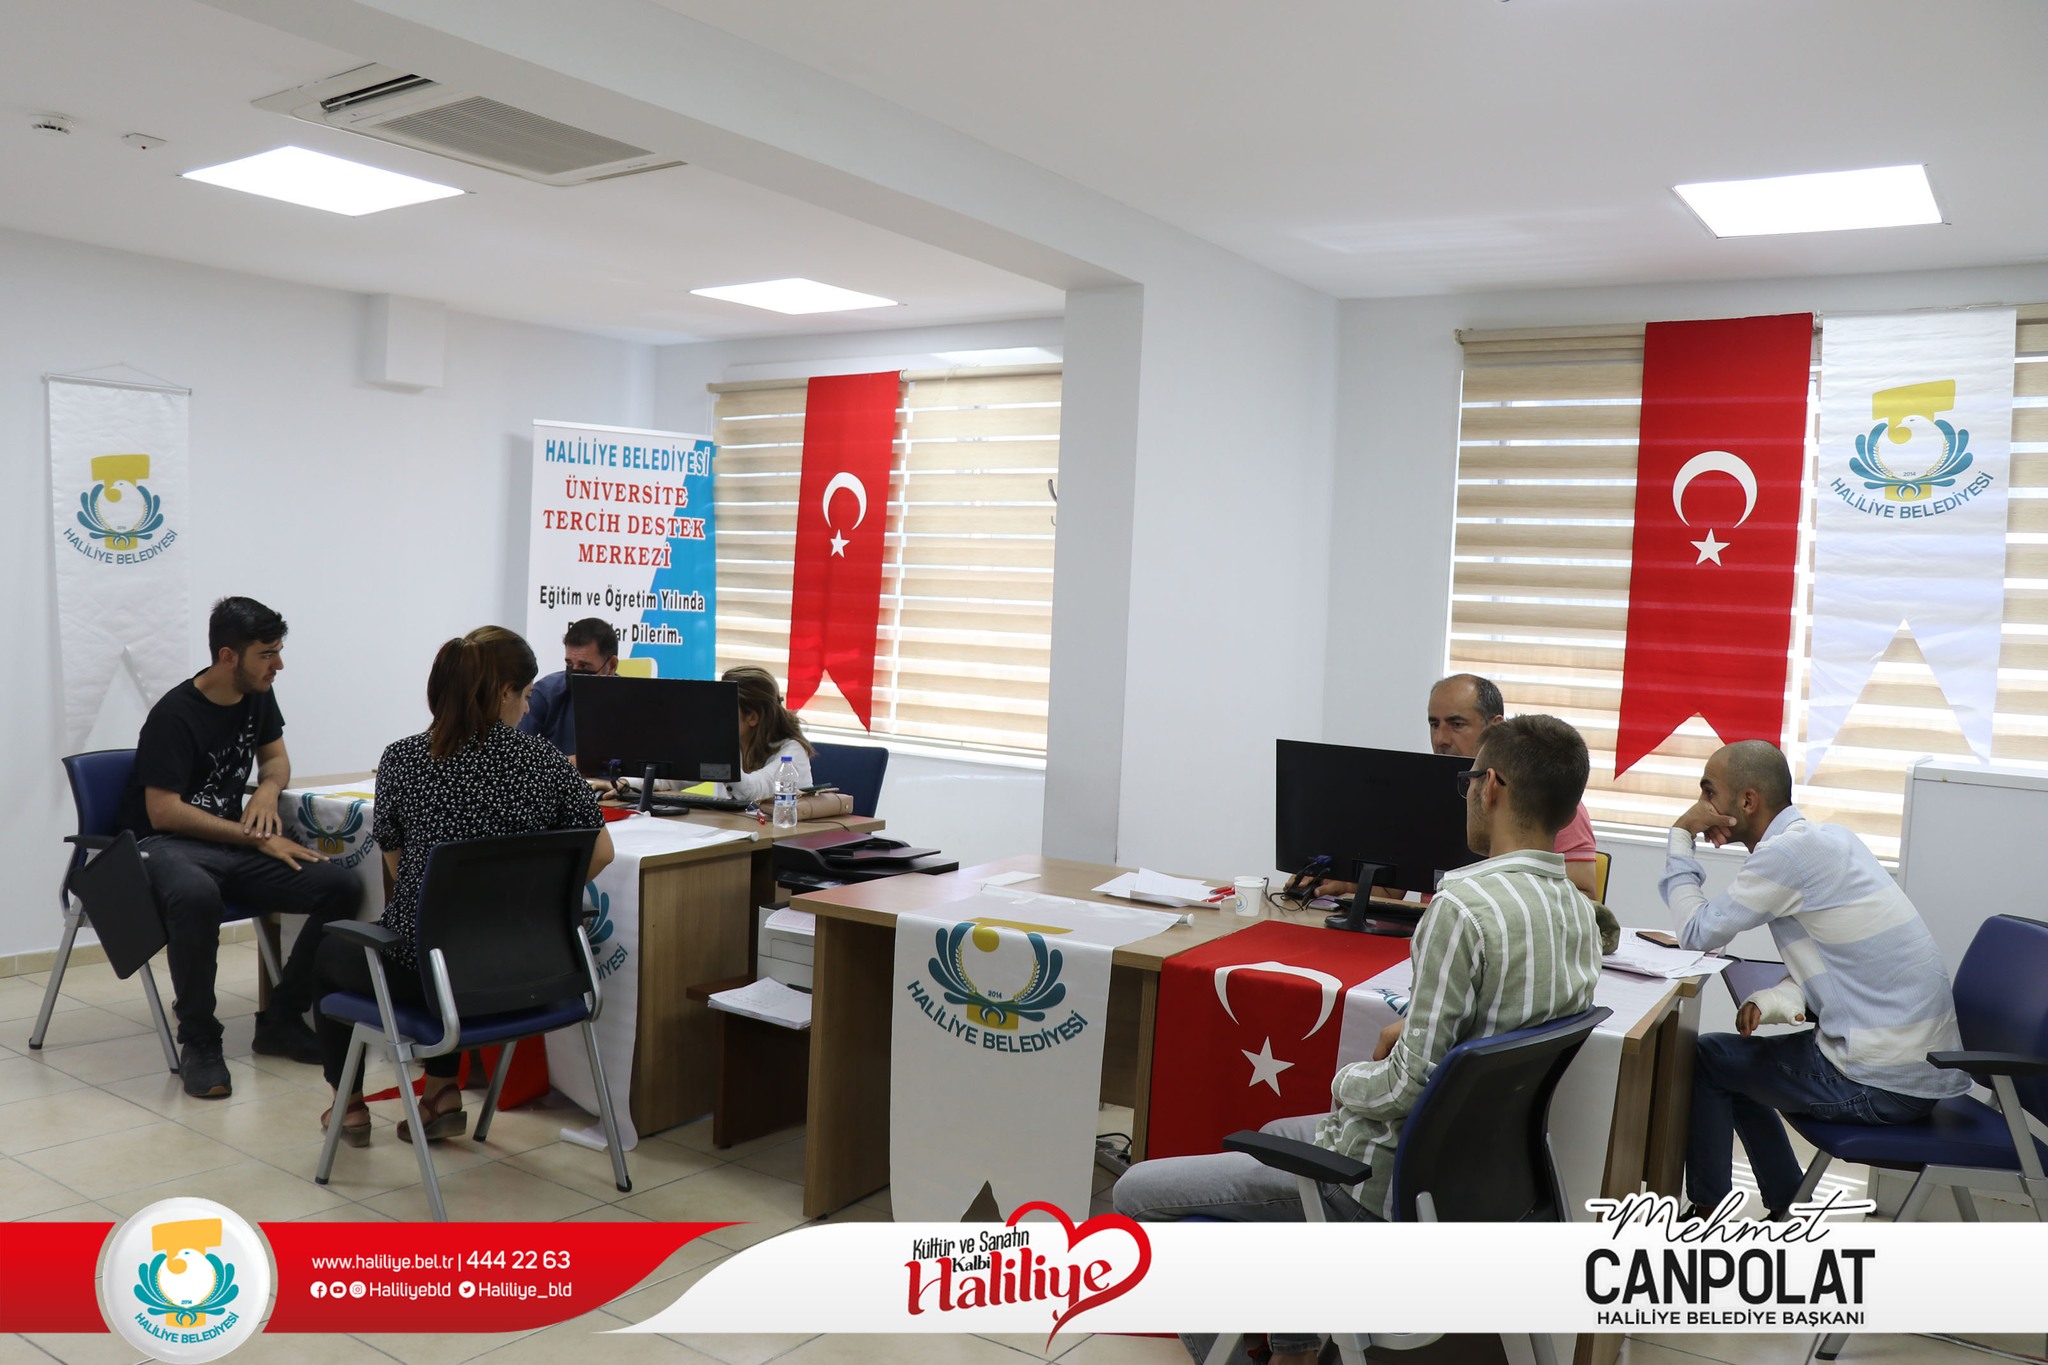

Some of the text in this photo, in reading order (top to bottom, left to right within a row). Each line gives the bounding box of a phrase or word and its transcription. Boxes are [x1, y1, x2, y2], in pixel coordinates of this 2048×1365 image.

[545, 436, 709, 475] HALİLİYE BELEDİYESİ
[565, 474, 687, 506] ÜNİVERSİTE
[1830, 470, 1995, 519] HALİLİYE BELEDİYESİ
[543, 508, 705, 539] TERCİH DESTEK
[63, 528, 178, 565] HALİLİYE BELEDİYESİ
[578, 543, 670, 567] MERKEZİ
[539, 584, 705, 612] Eğitim ve Öğretim Yılında
[631, 624, 682, 644] Dilerim.
[907, 980, 1089, 1053] HALİLİYE BELEDİYESİ
